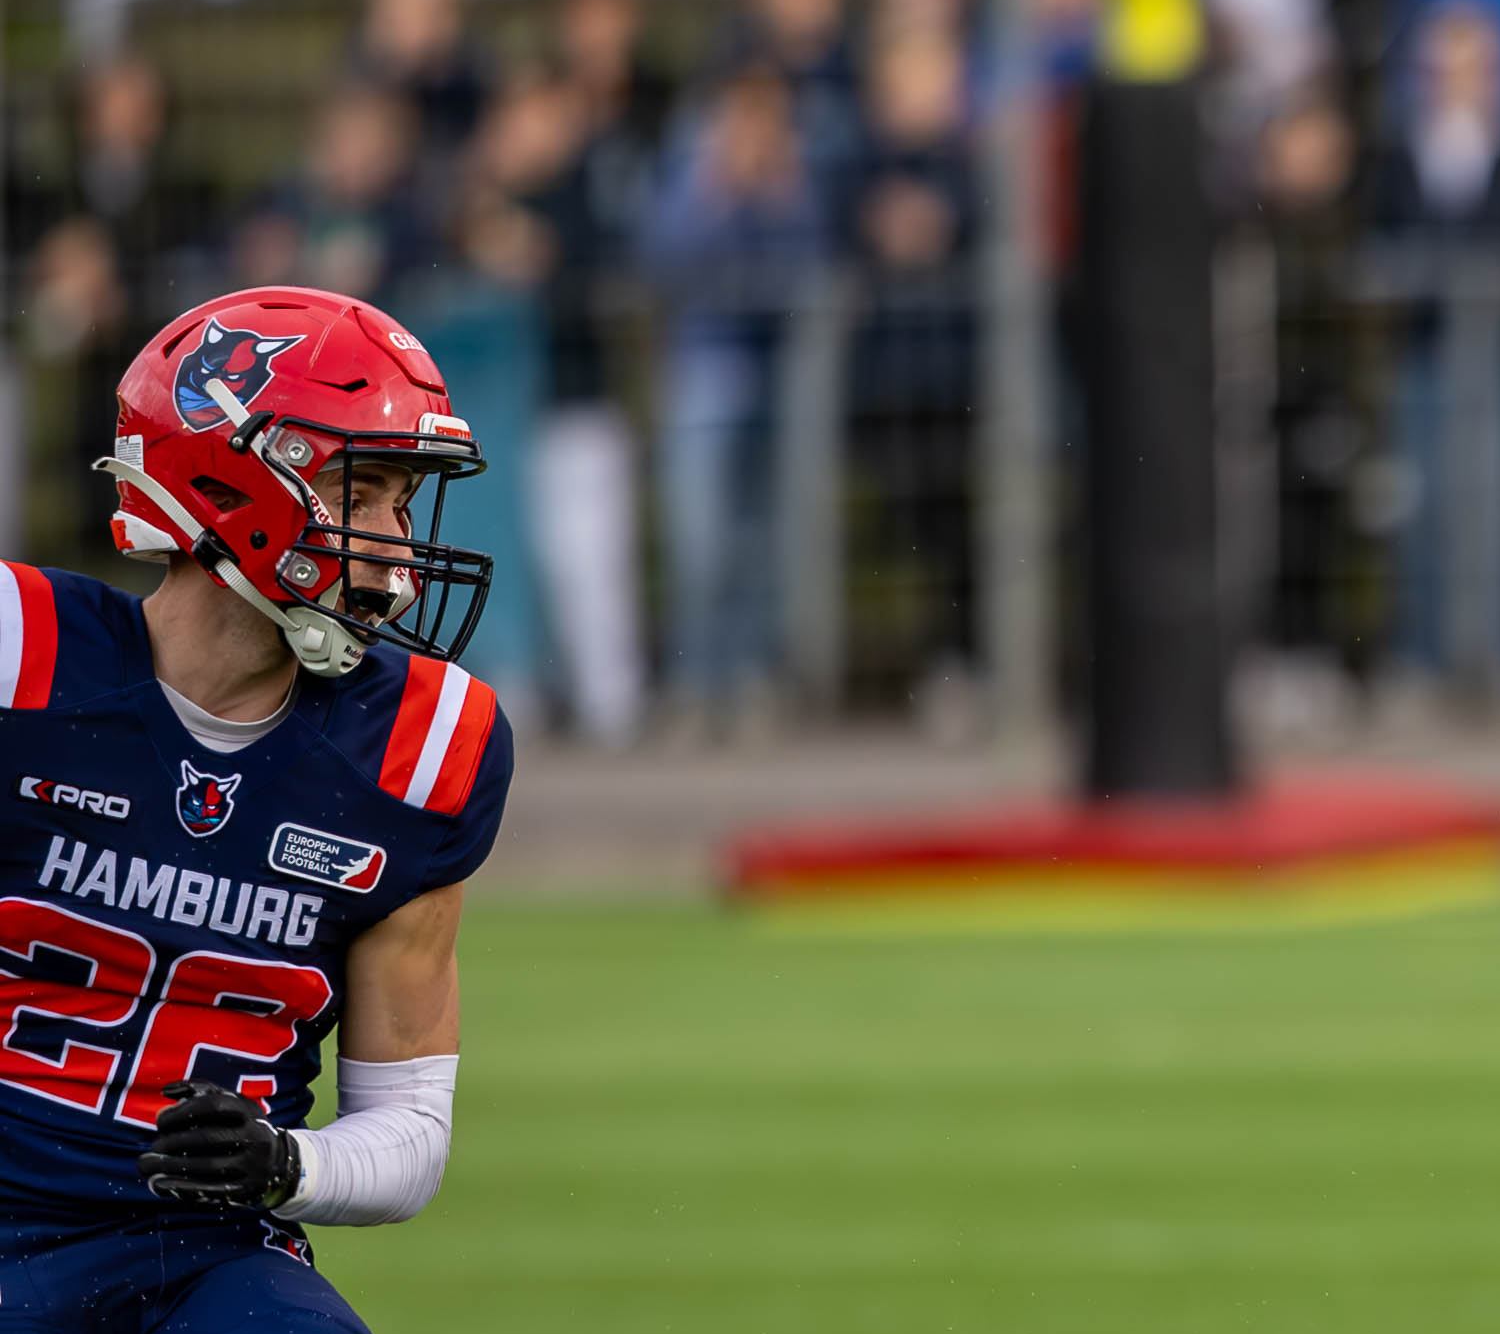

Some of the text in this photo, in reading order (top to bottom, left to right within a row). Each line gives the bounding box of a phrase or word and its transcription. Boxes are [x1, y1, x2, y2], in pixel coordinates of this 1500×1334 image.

[283, 842, 322, 862] LEAGUE
[286, 832, 341, 856] EUROPEAN
[281, 853, 331, 875] FOOTBALL
[38, 835, 325, 947] HAMBURG
